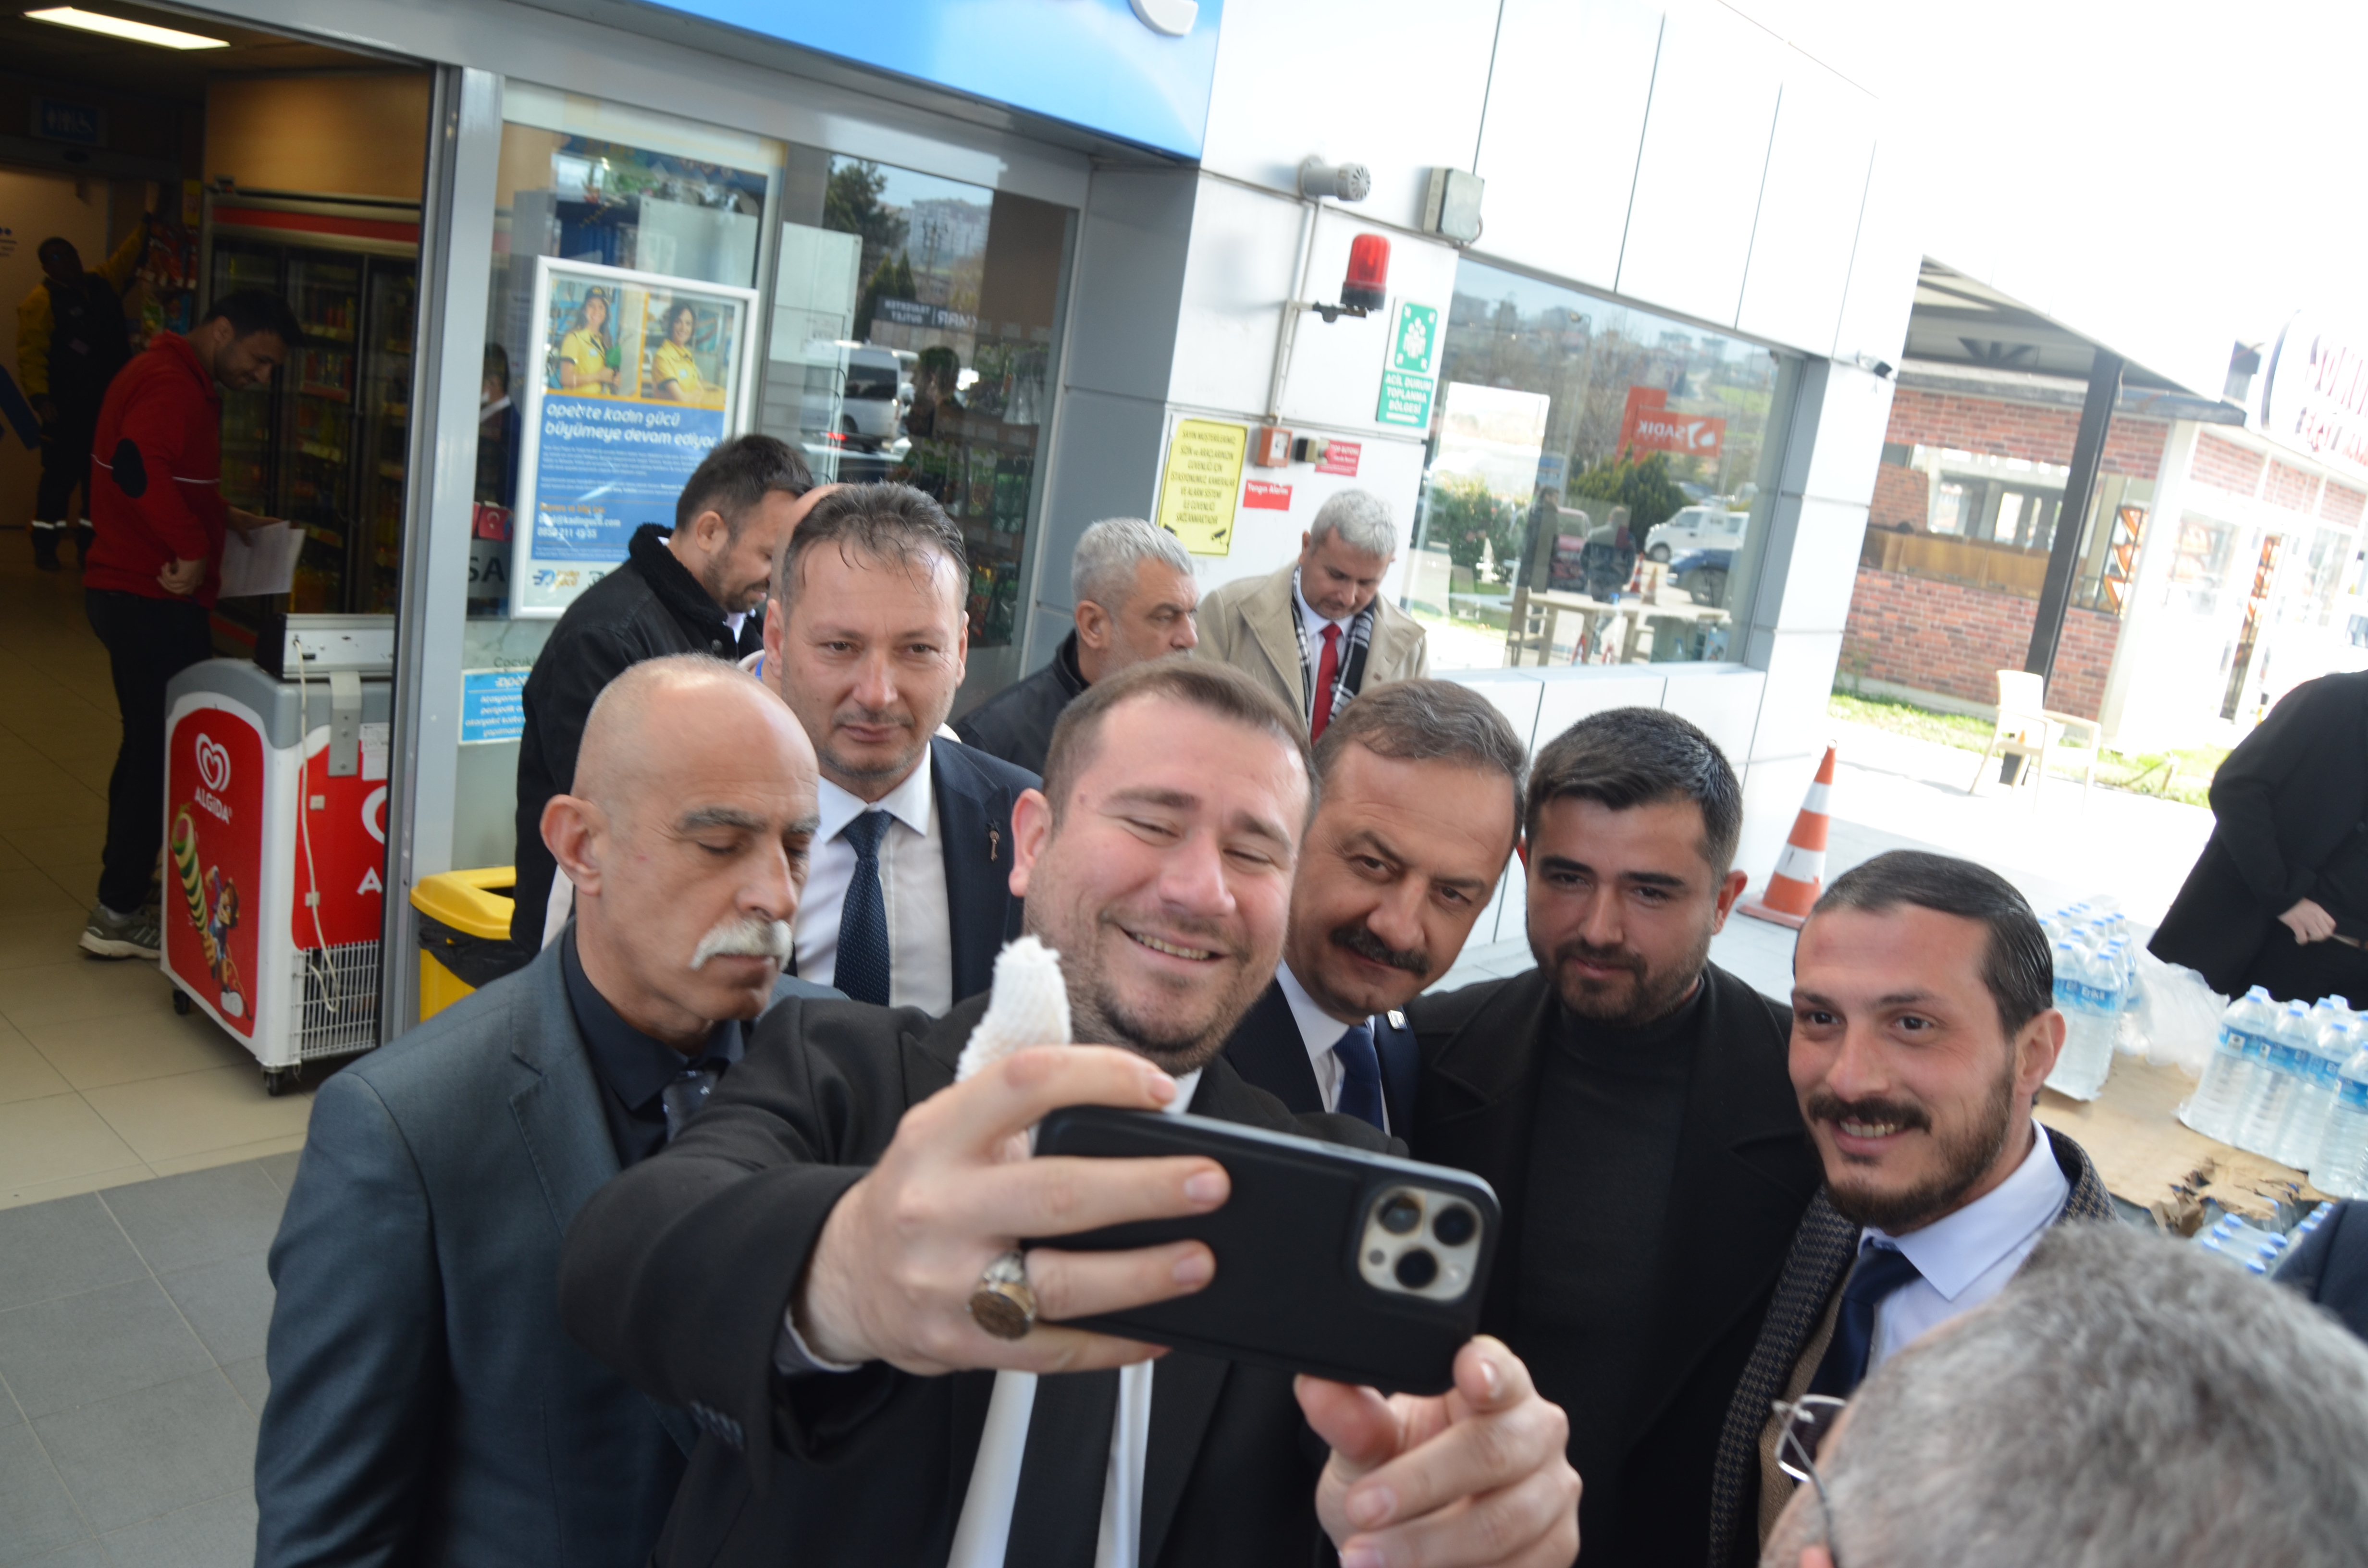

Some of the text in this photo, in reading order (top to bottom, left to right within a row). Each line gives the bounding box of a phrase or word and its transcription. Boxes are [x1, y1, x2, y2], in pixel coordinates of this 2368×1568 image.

[1386, 373, 1432, 392] ACİL DURUM
[1387, 386, 1427, 404] TOPLANMA
[1389, 398, 1421, 415] BÖLGESİ
[604, 407, 644, 425] kadın
[645, 411, 680, 428] gücü
[544, 420, 622, 443] büyümeye
[624, 427, 672, 445] devam
